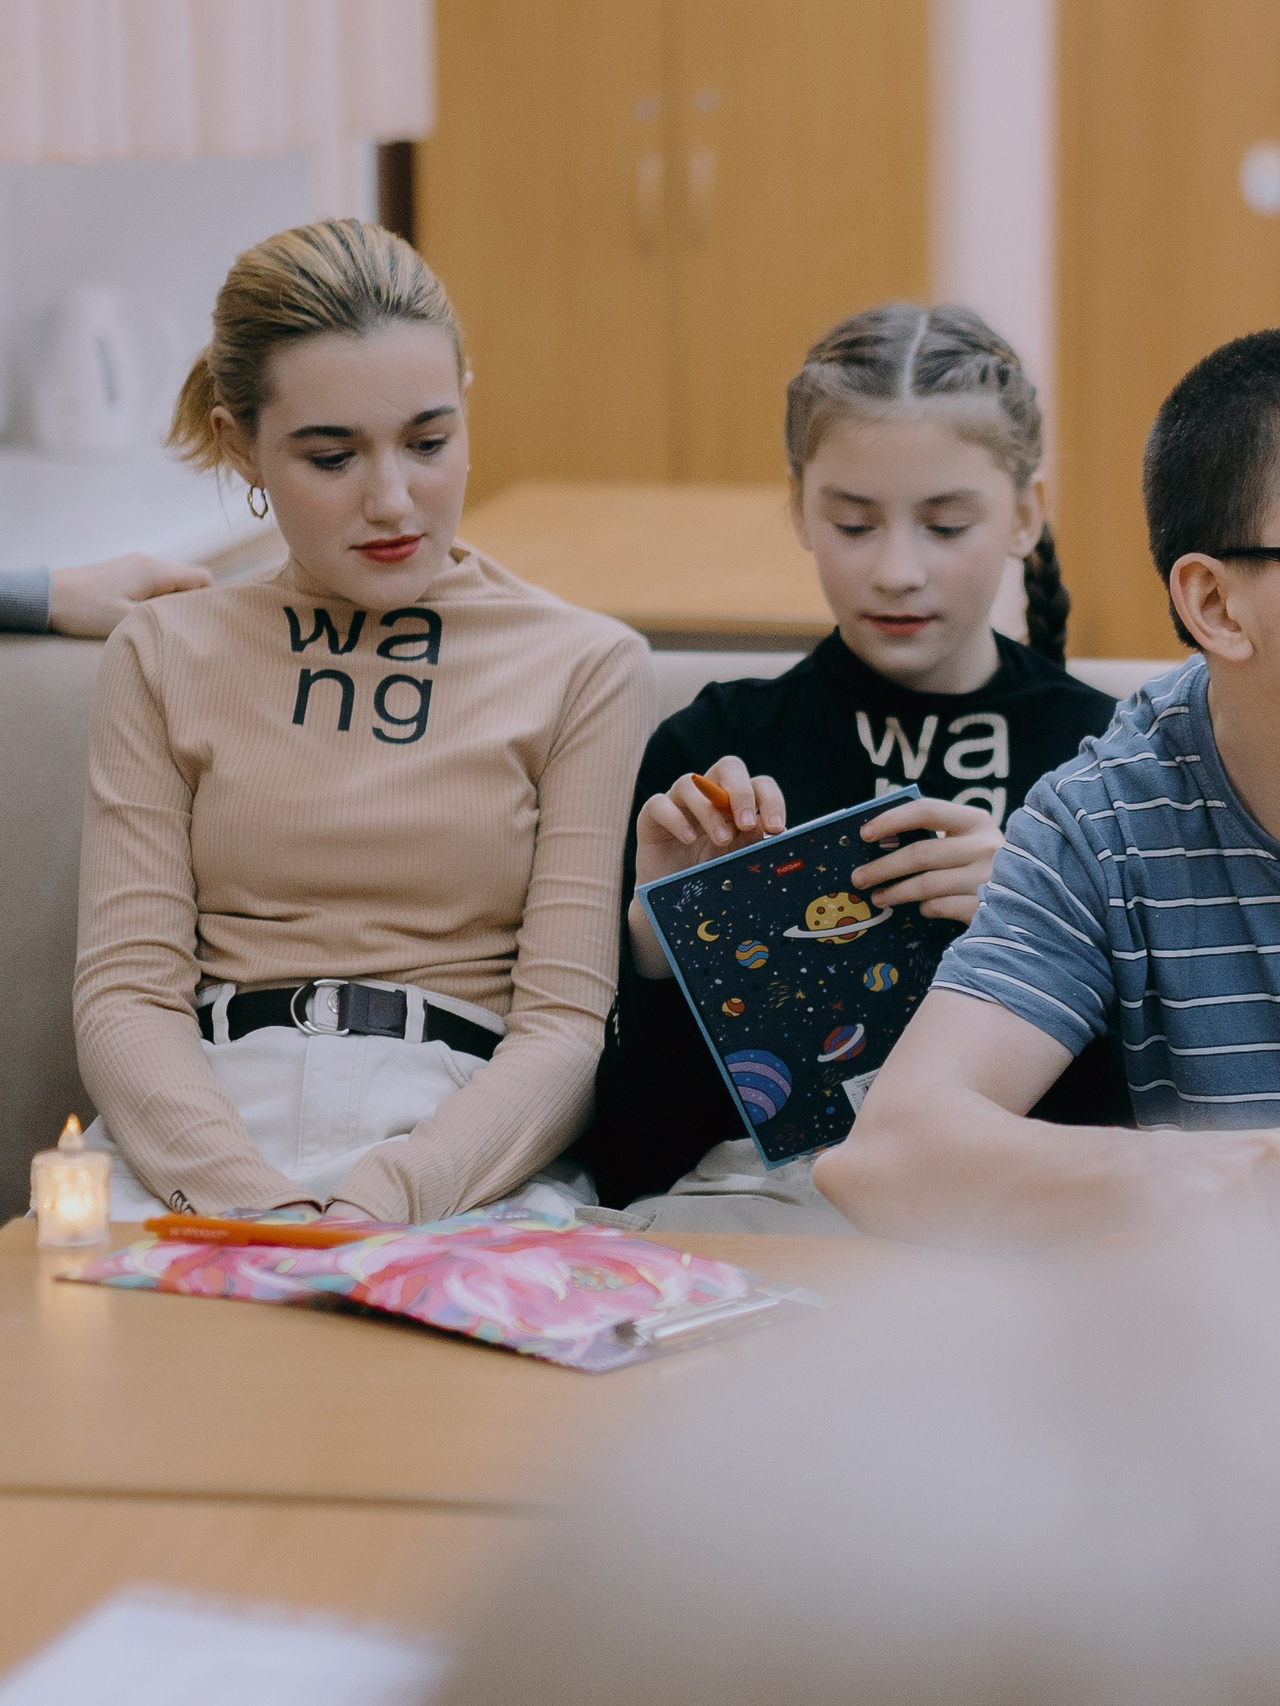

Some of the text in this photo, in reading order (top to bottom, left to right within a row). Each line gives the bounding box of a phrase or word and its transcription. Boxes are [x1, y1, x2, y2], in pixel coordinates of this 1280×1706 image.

[283, 606, 443, 666] wa
[292, 668, 434, 745] ng
[855, 711, 1009, 780] wa
